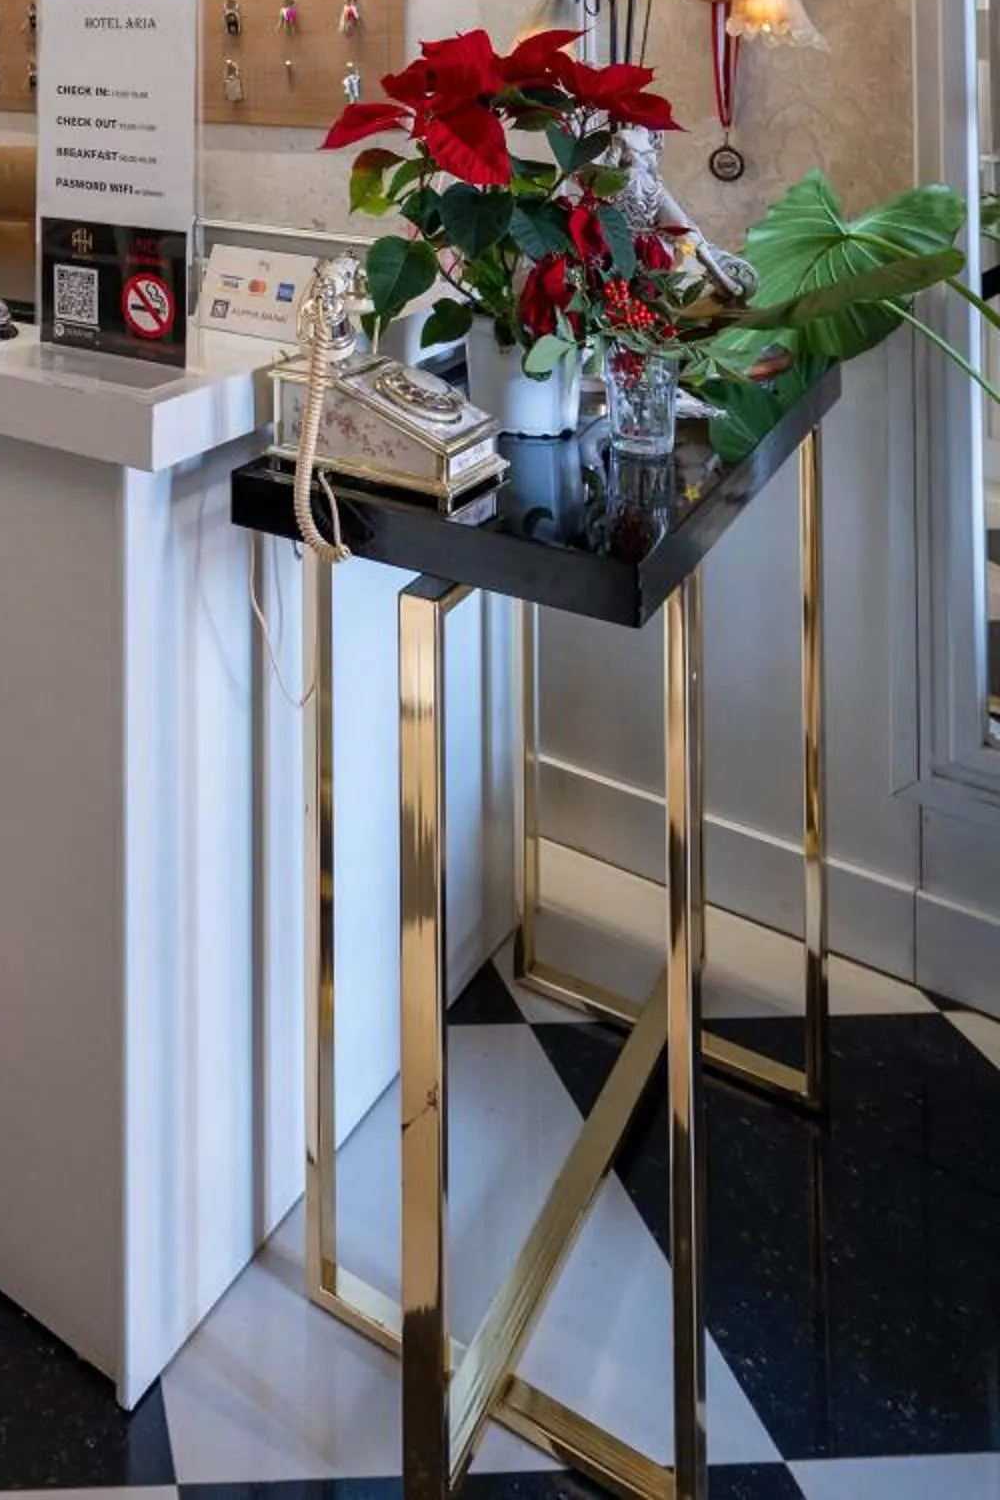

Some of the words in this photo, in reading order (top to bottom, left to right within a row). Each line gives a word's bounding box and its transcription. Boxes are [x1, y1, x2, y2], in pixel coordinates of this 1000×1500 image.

[85, 17, 122, 29] HOTEL
[125, 17, 156, 29] ARIA
[56, 85, 92, 96] CHECK
[56, 116, 92, 127] CHECK
[95, 118, 117, 129] OUT
[56, 148, 119, 161] BREAKFAST
[109, 183, 133, 194] WIFI
